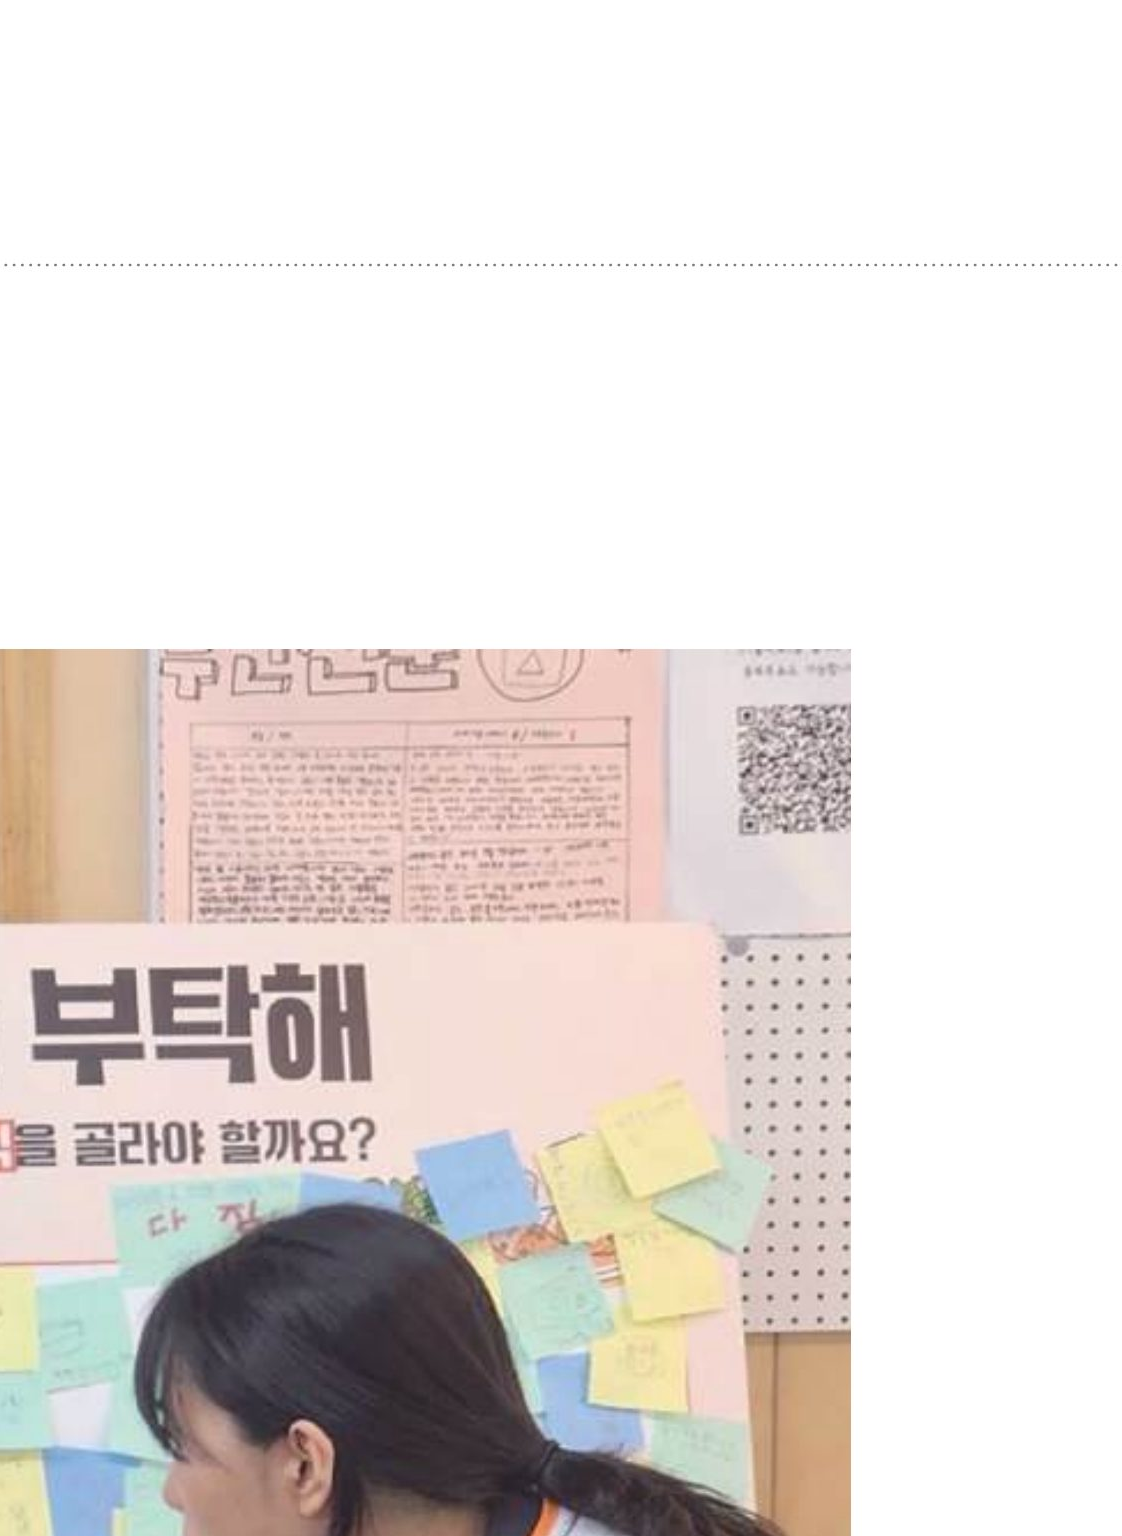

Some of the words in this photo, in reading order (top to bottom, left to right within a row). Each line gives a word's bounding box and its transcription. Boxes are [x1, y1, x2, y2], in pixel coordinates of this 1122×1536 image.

[30, 963, 373, 1087] 부탁해
[73, 1120, 205, 1166] 골라야
[220, 1116, 377, 1162] 할까요?
